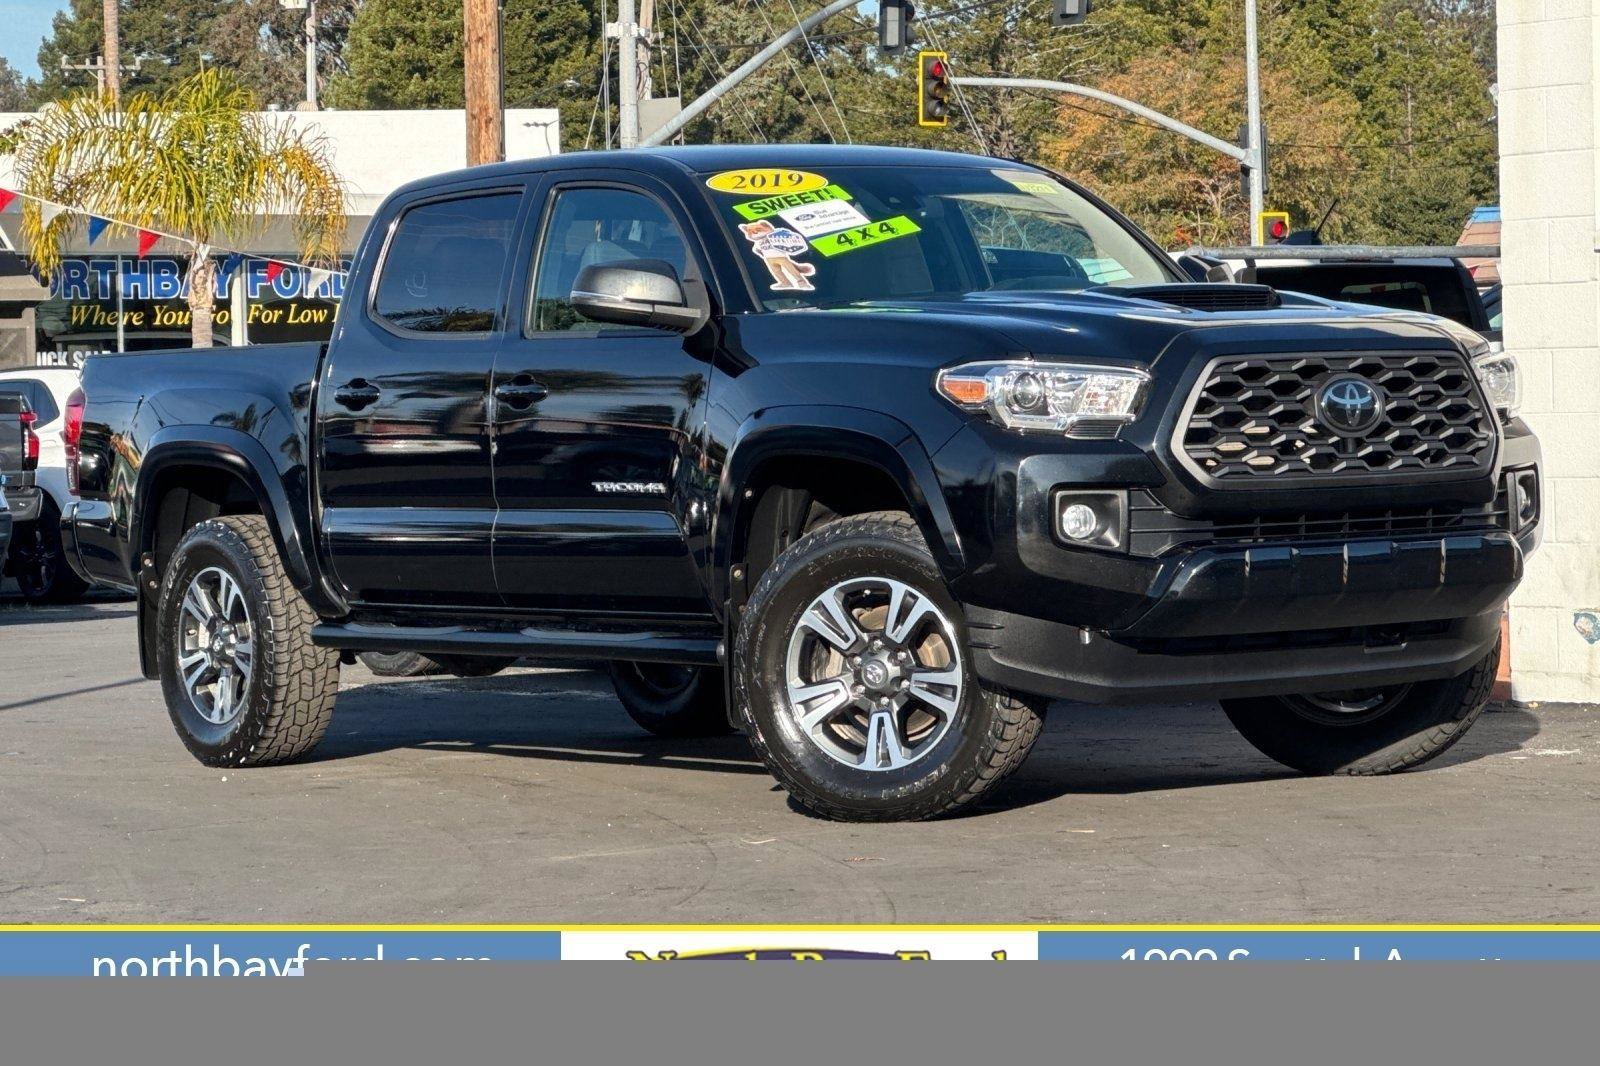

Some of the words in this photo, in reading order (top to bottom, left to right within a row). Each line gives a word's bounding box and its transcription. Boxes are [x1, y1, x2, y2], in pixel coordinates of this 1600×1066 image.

[731, 173, 804, 190] 2019
[747, 188, 836, 215] SWEET!
[71, 304, 145, 327] Where
[152, 304, 192, 326] You
[248, 303, 283, 325] For
[287, 303, 332, 324] Low
